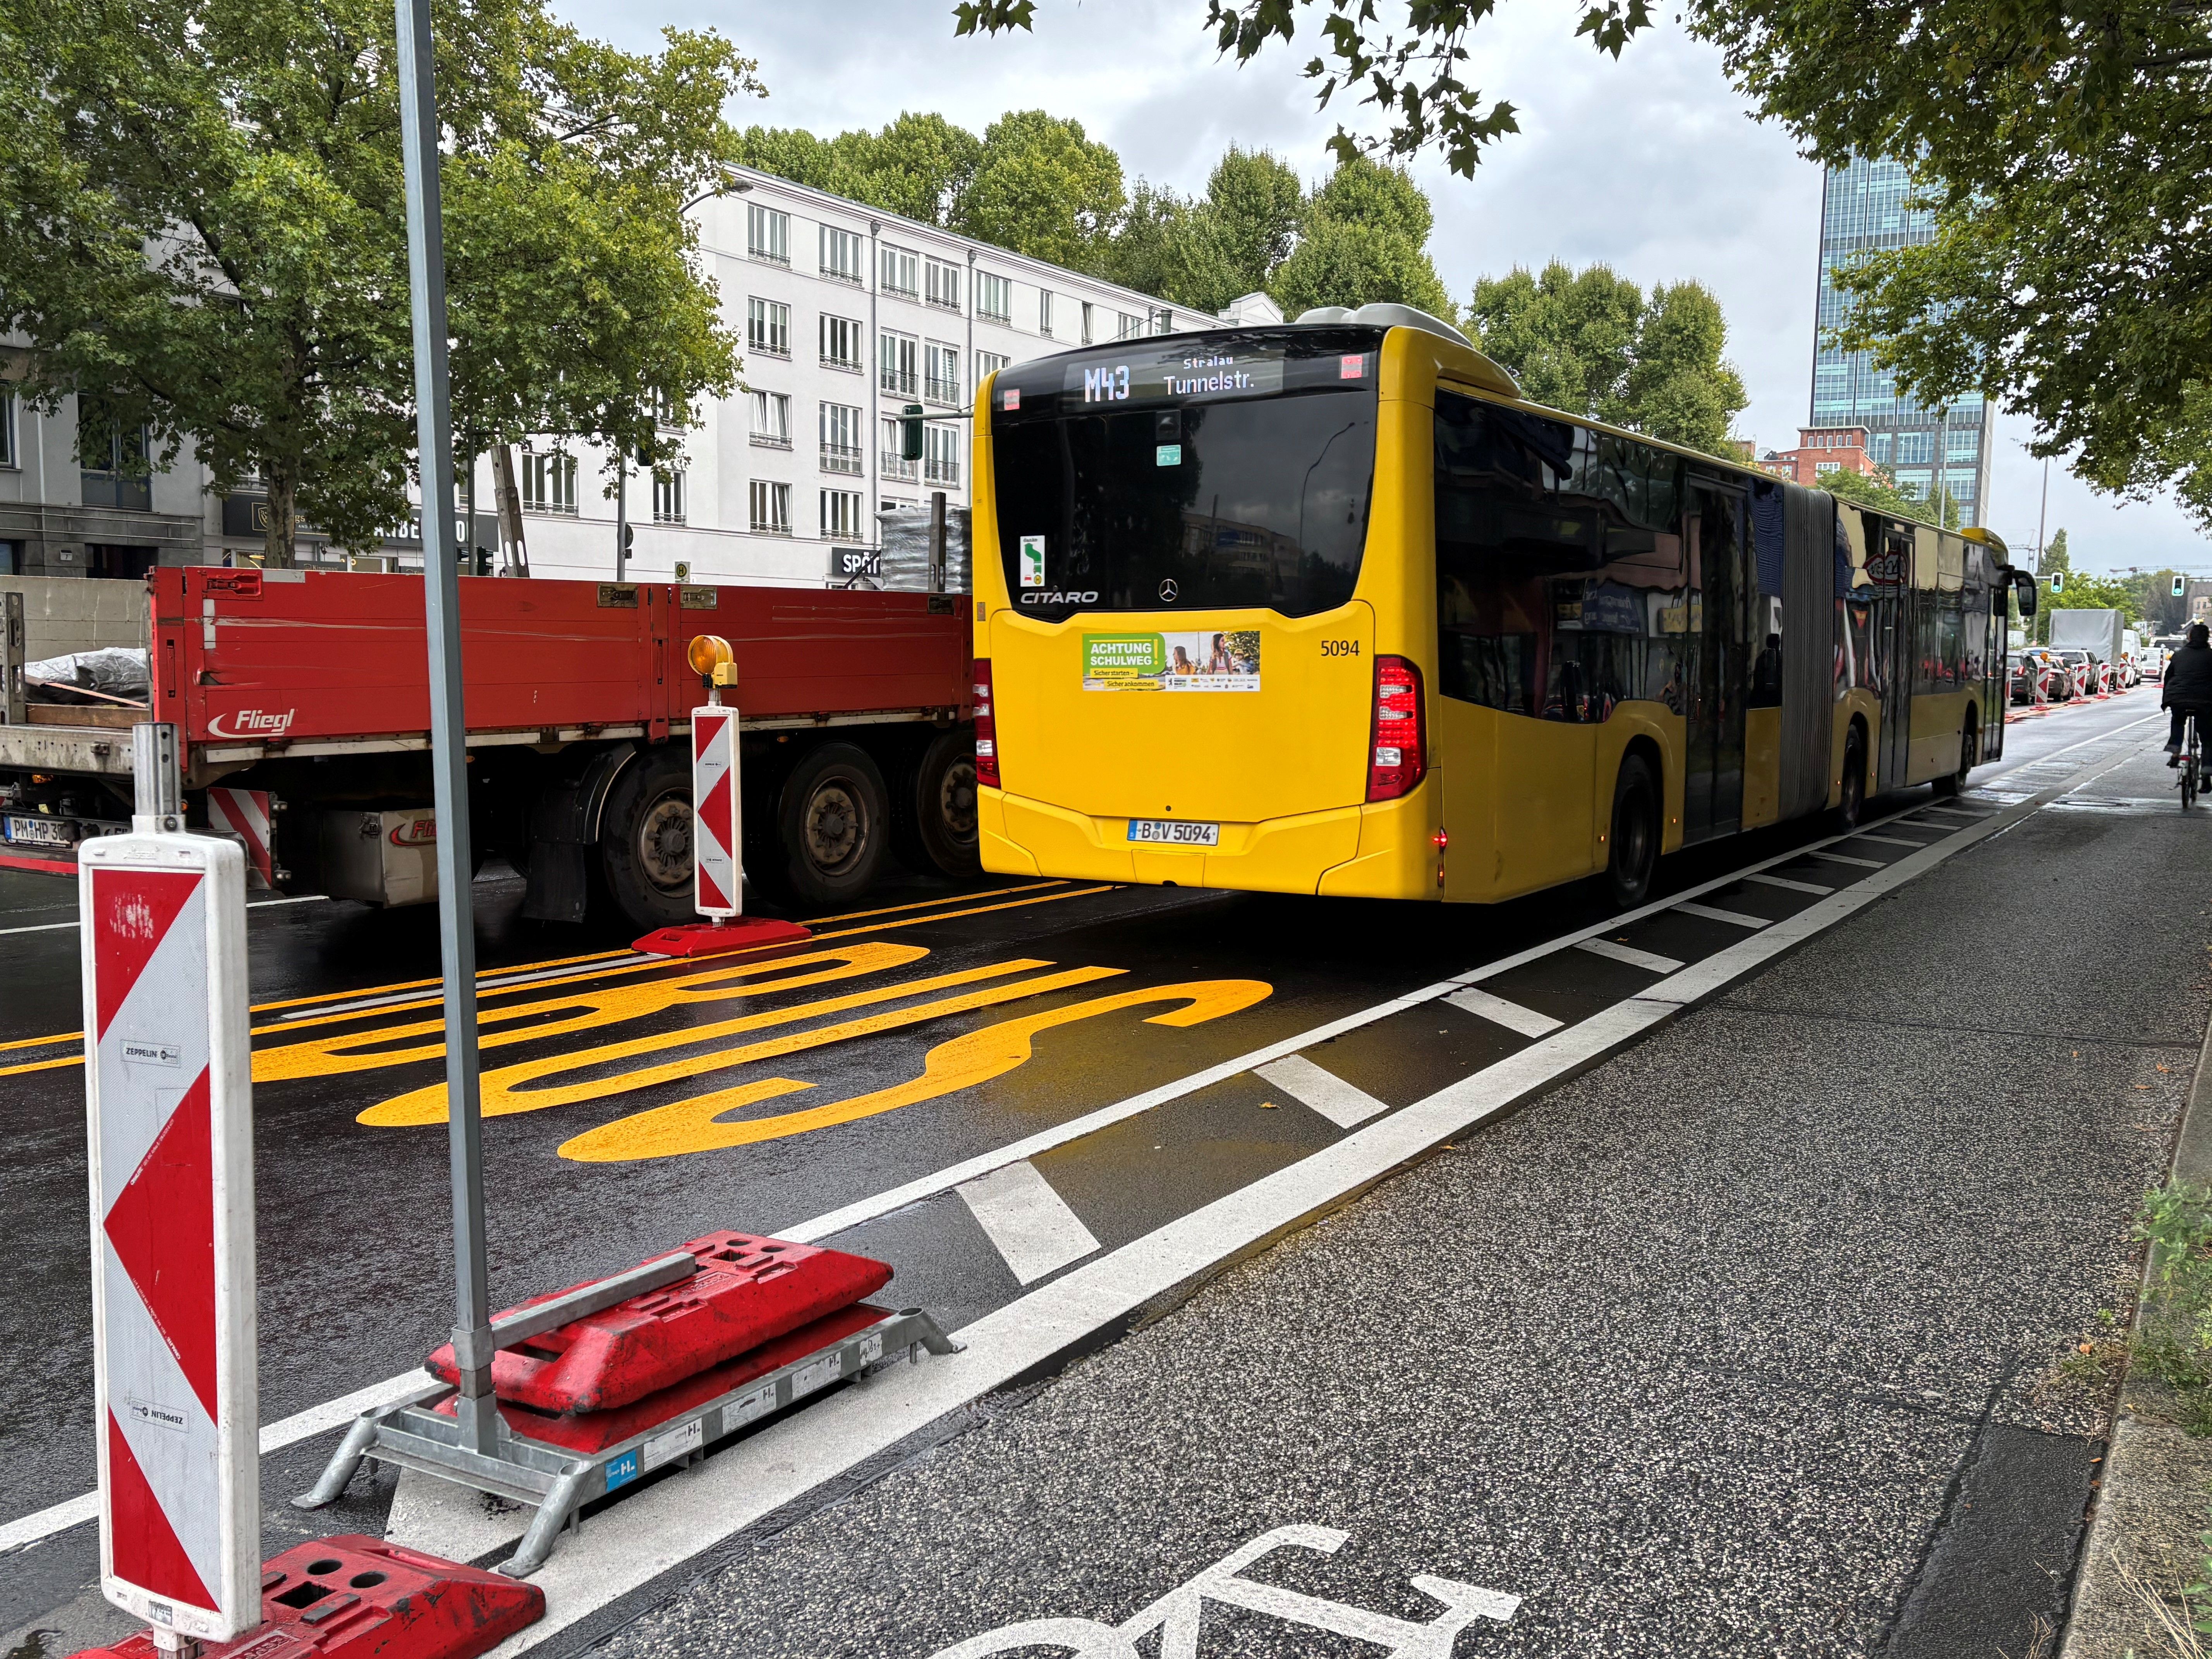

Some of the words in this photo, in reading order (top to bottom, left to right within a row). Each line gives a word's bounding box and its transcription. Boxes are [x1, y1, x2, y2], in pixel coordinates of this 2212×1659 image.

[1183, 356, 1233, 369] Stralau
[1084, 365, 1130, 403] M43
[1163, 370, 1255, 395] Tunnelstr.
[1020, 591, 1099, 604] CITARO
[1091, 642, 1152, 654] ACHTUNG
[1321, 640, 1360, 656] 5094
[1090, 655, 1152, 666] SCHULWEG
[235, 708, 295, 732] Fliegl
[14, 819, 27, 838] PM
[34, 821, 48, 839] HP
[1142, 823, 1151, 839] B
[1173, 824, 1211, 842] 5094
[125, 1047, 158, 1058] ZEPPELIN
[250, 941, 1275, 1163] BUS
[151, 1410, 183, 1424] ZEPPELIN
